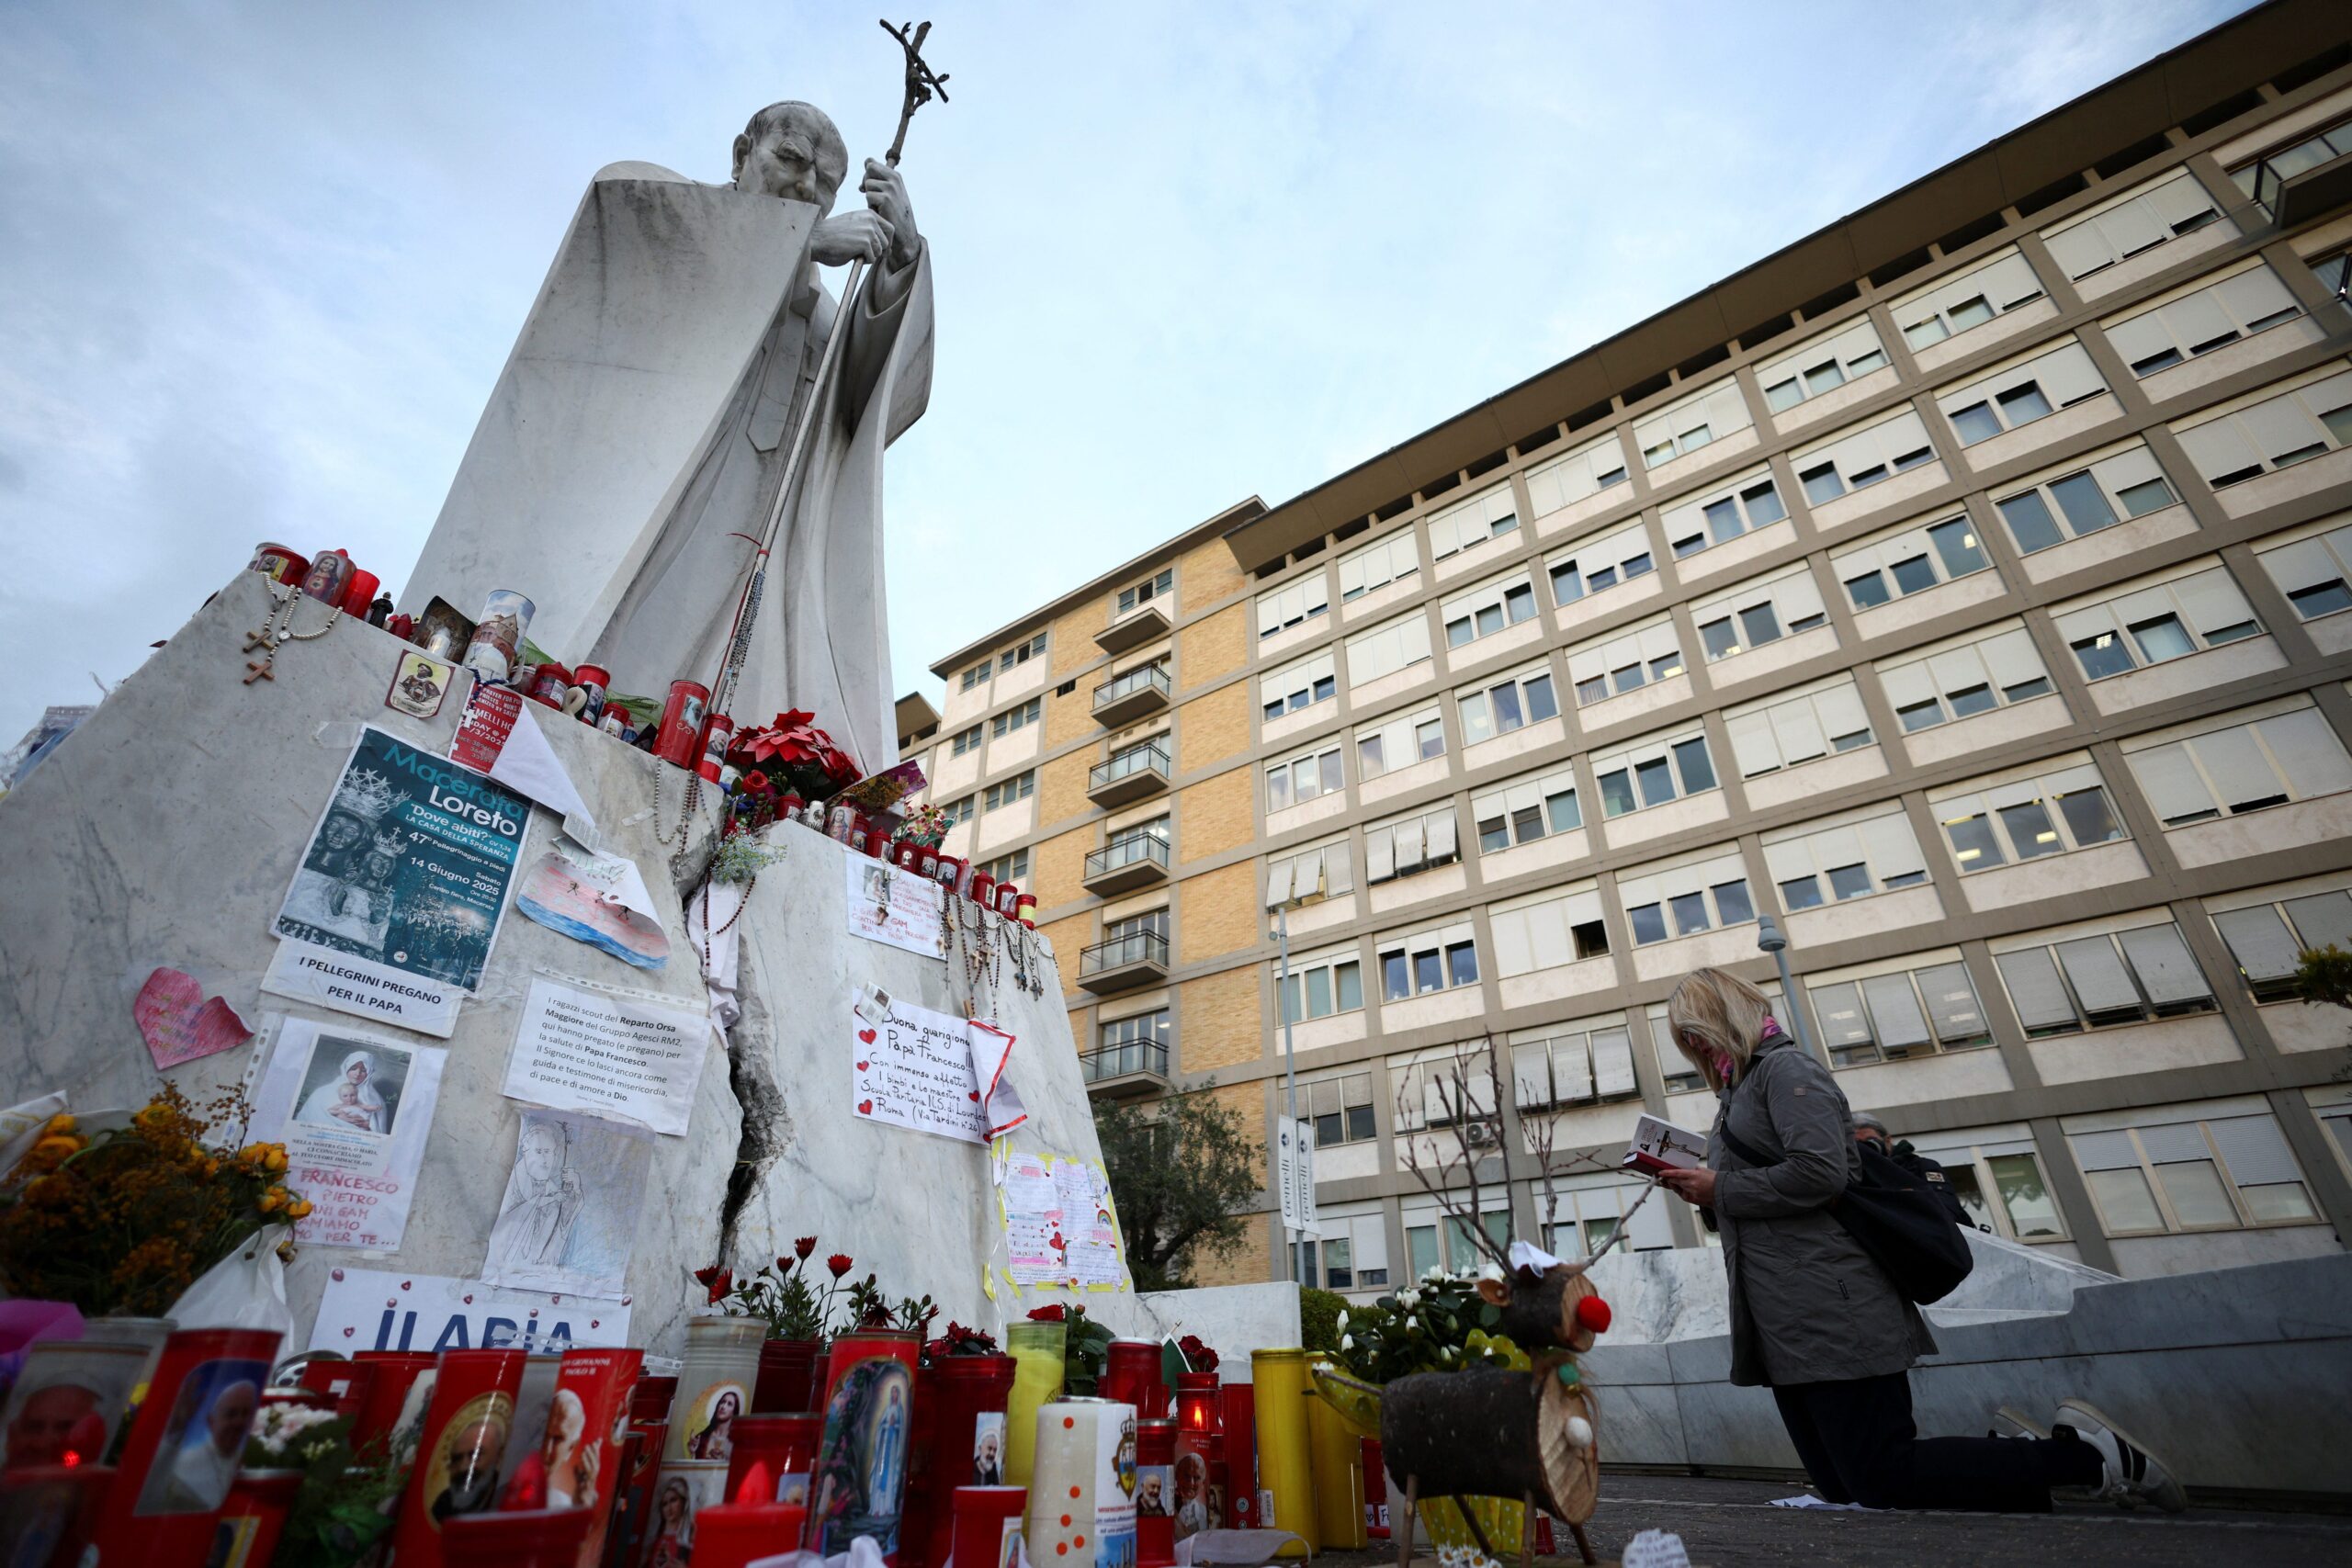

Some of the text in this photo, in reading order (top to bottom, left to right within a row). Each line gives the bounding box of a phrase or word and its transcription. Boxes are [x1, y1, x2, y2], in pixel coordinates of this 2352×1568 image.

[480, 693, 498, 705] PRIESTS
[483, 687, 502, 698] PRAYER
[473, 706, 514, 731] EMELLI HO
[383, 744, 524, 819] Macerata
[429, 785, 517, 836] Loreto
[405, 814, 509, 861] LA CASA DELLA SPERANZA
[433, 840, 481, 863] Pellegrinaggio
[489, 862, 506, 873] piedi
[411, 857, 500, 896] 14 Giugno 2025
[429, 883, 449, 895] Centro
[476, 872, 502, 886] Sabato
[890, 918, 908, 929] GAM
[300, 956, 442, 1005] I PELLEGRINI PREGANO
[327, 986, 402, 1014] PER IL PAPA
[552, 998, 580, 1015] ragazzi
[582, 1007, 604, 1021] scout
[605, 1012, 618, 1023] del
[619, 1016, 654, 1032] Reparto
[656, 1022, 676, 1033] Orsa
[542, 1021, 681, 1061] qui hanno pregato (e pregano) per
[545, 1008, 683, 1048] Maggiore del Gruppo Agesci RM2,
[539, 1032, 649, 1067] la salute di Papa Francesco.
[888, 1029, 915, 1060] Papa
[533, 1058, 557, 1072] guida
[566, 1066, 606, 1083] testimone
[608, 1075, 616, 1086] di
[616, 1079, 669, 1098] misericordia,
[537, 1044, 667, 1084] Il Signore ce lo lasci ancora come
[870, 1052, 967, 1089] Con immenso affetto
[530, 1070, 538, 1078] di
[539, 1073, 561, 1085] pace
[570, 1079, 578, 1089] di
[579, 1083, 606, 1096] amore
[614, 1091, 629, 1102] Dio.
[861, 1079, 891, 1099] Scuola
[893, 1085, 927, 1106] Paritaria
[948, 1103, 955, 1112] di
[956, 1105, 987, 1122] Lourdes
[887, 1072, 907, 1087] bimbi
[919, 1082, 928, 1093] le
[930, 1089, 961, 1102] maestre
[876, 1097, 905, 1117] Roma
[912, 1105, 930, 1123] (Via
[930, 1109, 959, 1127] Tardini
[300, 1168, 399, 1194] FRANCESCO
[1281, 1159, 1292, 1217] Gemelli
[322, 1189, 379, 1206] PIETRO
[338, 1205, 369, 1220] GAM
[325, 1231, 351, 1243] PER
